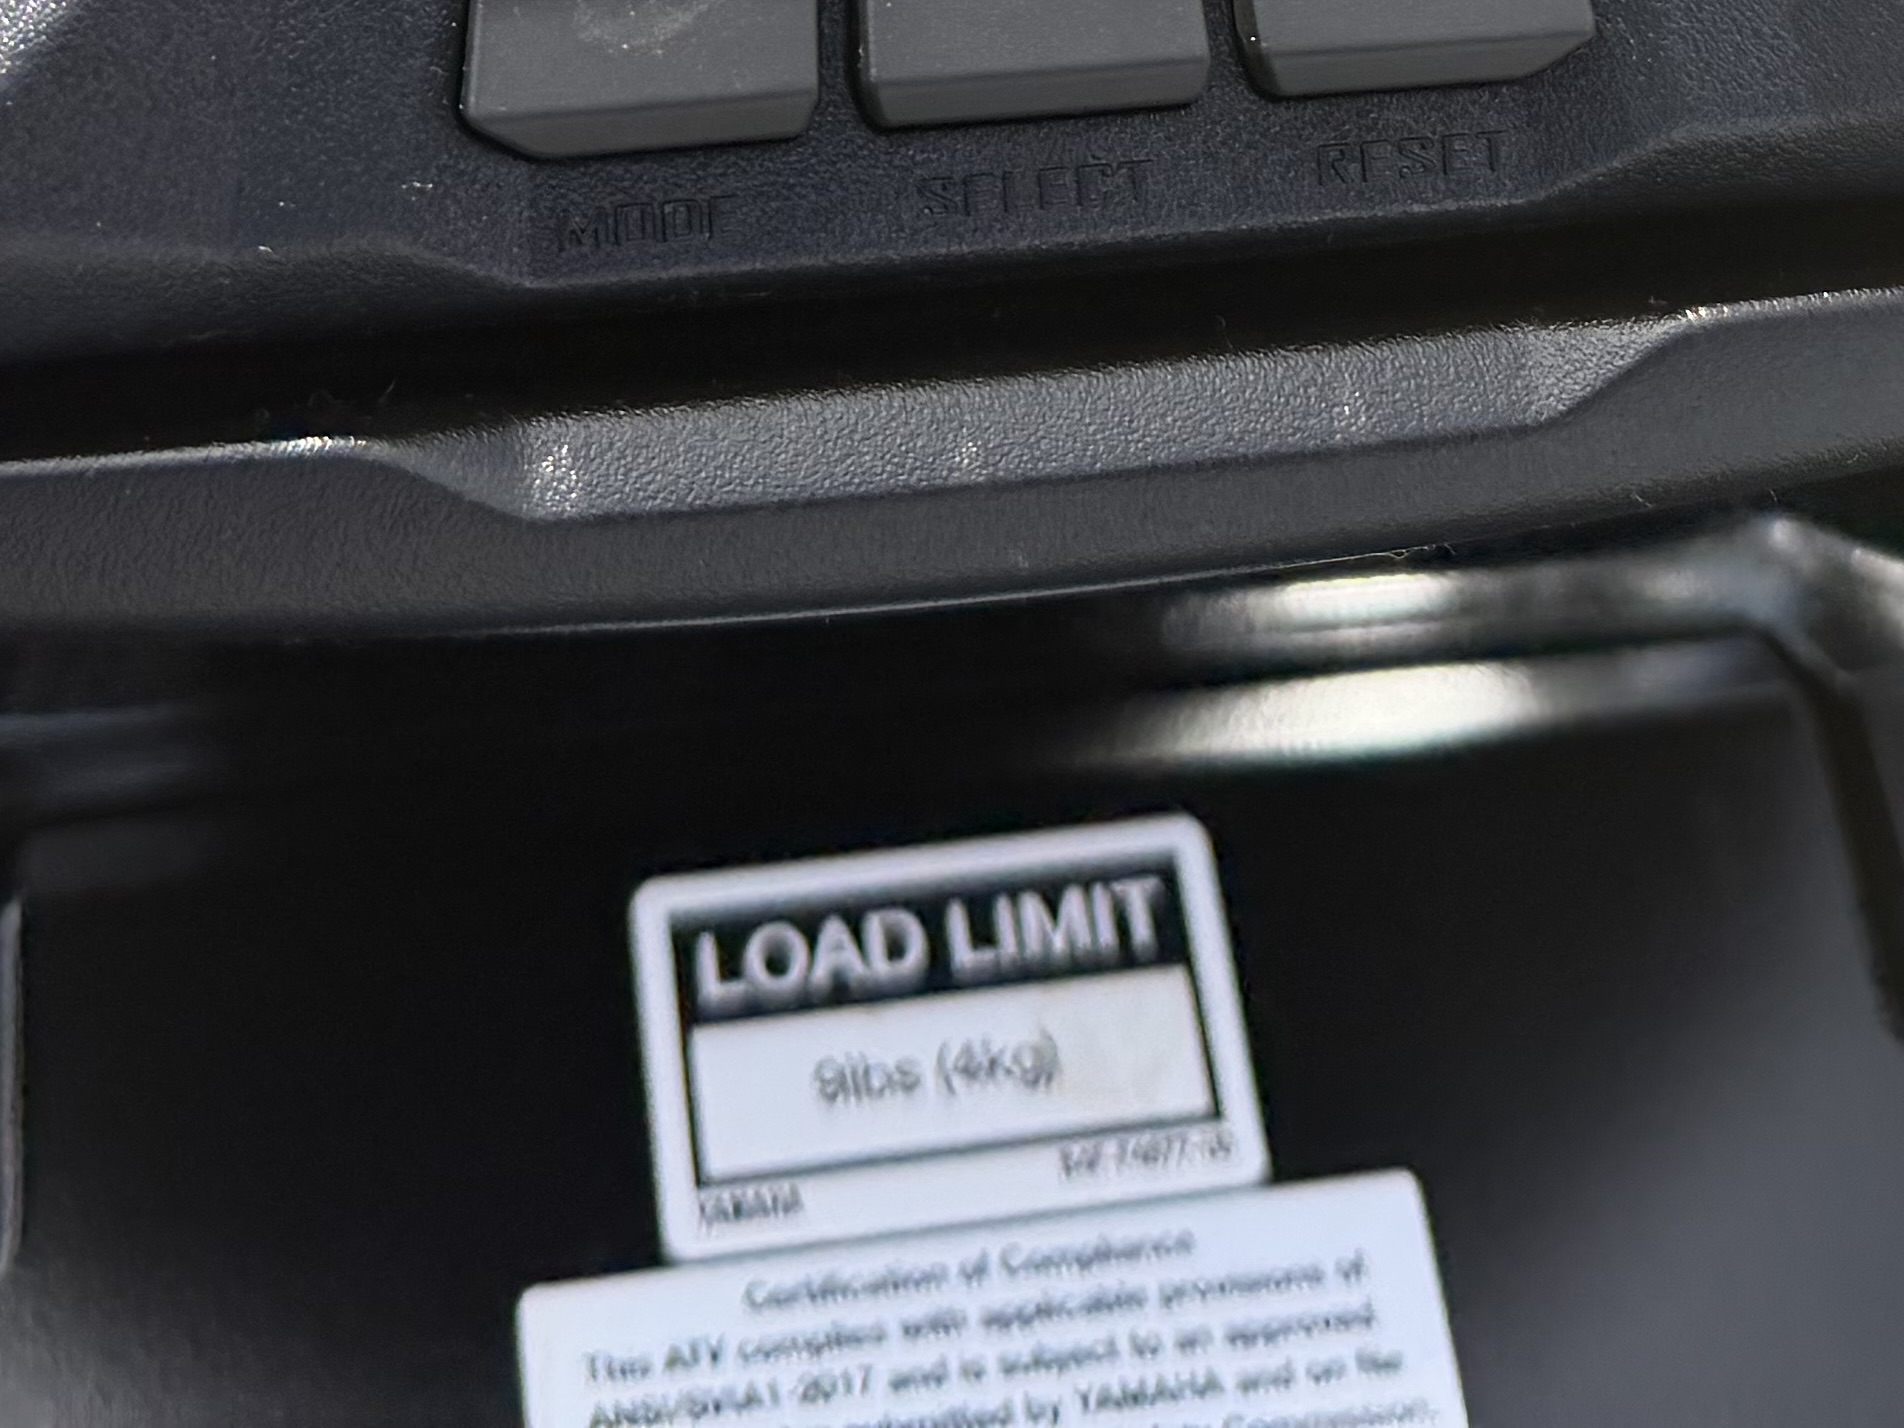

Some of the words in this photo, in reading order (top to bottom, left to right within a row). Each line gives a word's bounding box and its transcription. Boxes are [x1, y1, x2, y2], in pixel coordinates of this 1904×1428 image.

[1317, 129, 1509, 186] RESET
[915, 158, 1154, 220] SELECT
[558, 194, 736, 250] MODE
[699, 908, 928, 1008] LOAD
[949, 876, 1162, 970] LIMIT
[934, 1028, 1063, 1097] (4kg)
[742, 1262, 950, 1314] Certification
[1000, 1228, 1197, 1278] Compliance
[663, 1334, 727, 1372] ATV
[1074, 1365, 1225, 1414] YAMAHA
